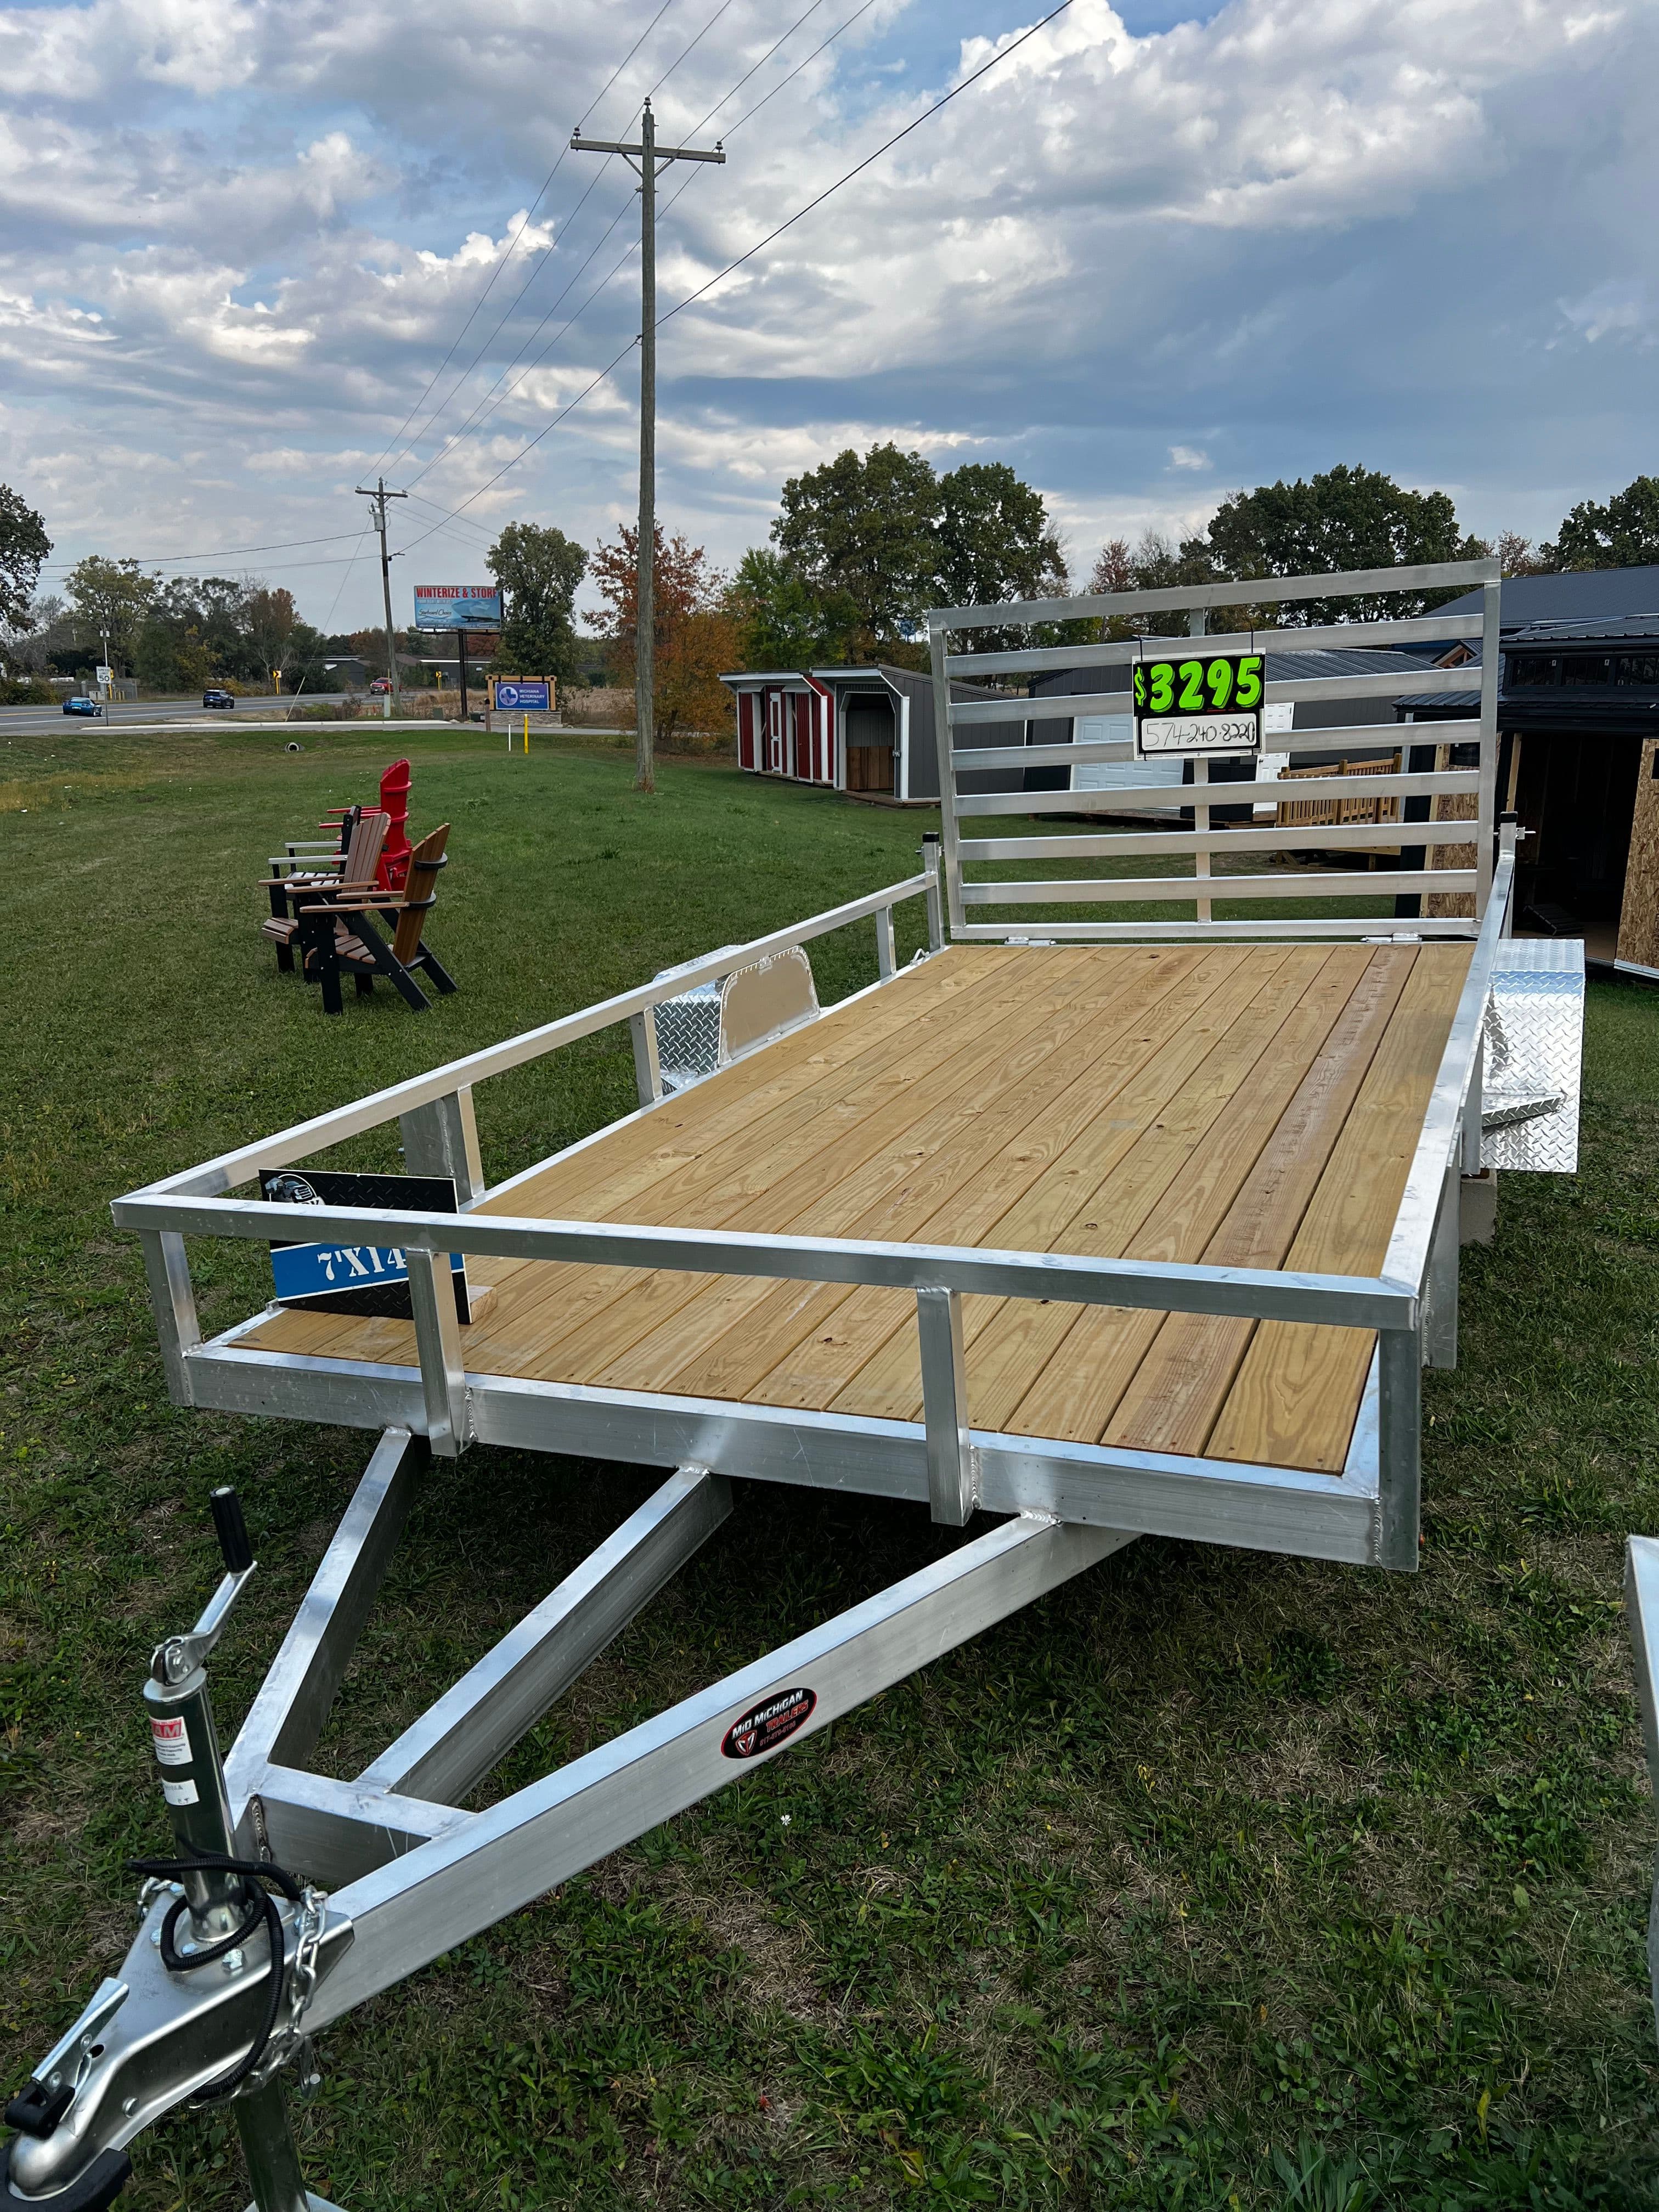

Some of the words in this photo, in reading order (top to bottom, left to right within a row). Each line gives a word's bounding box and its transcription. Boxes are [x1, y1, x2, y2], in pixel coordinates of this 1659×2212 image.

[416, 588, 460, 598] WINTERIZE
[462, 588, 469, 598] &
[1134, 656, 1262, 713] $3295
[766, 1699, 809, 1733] TRAILERS
